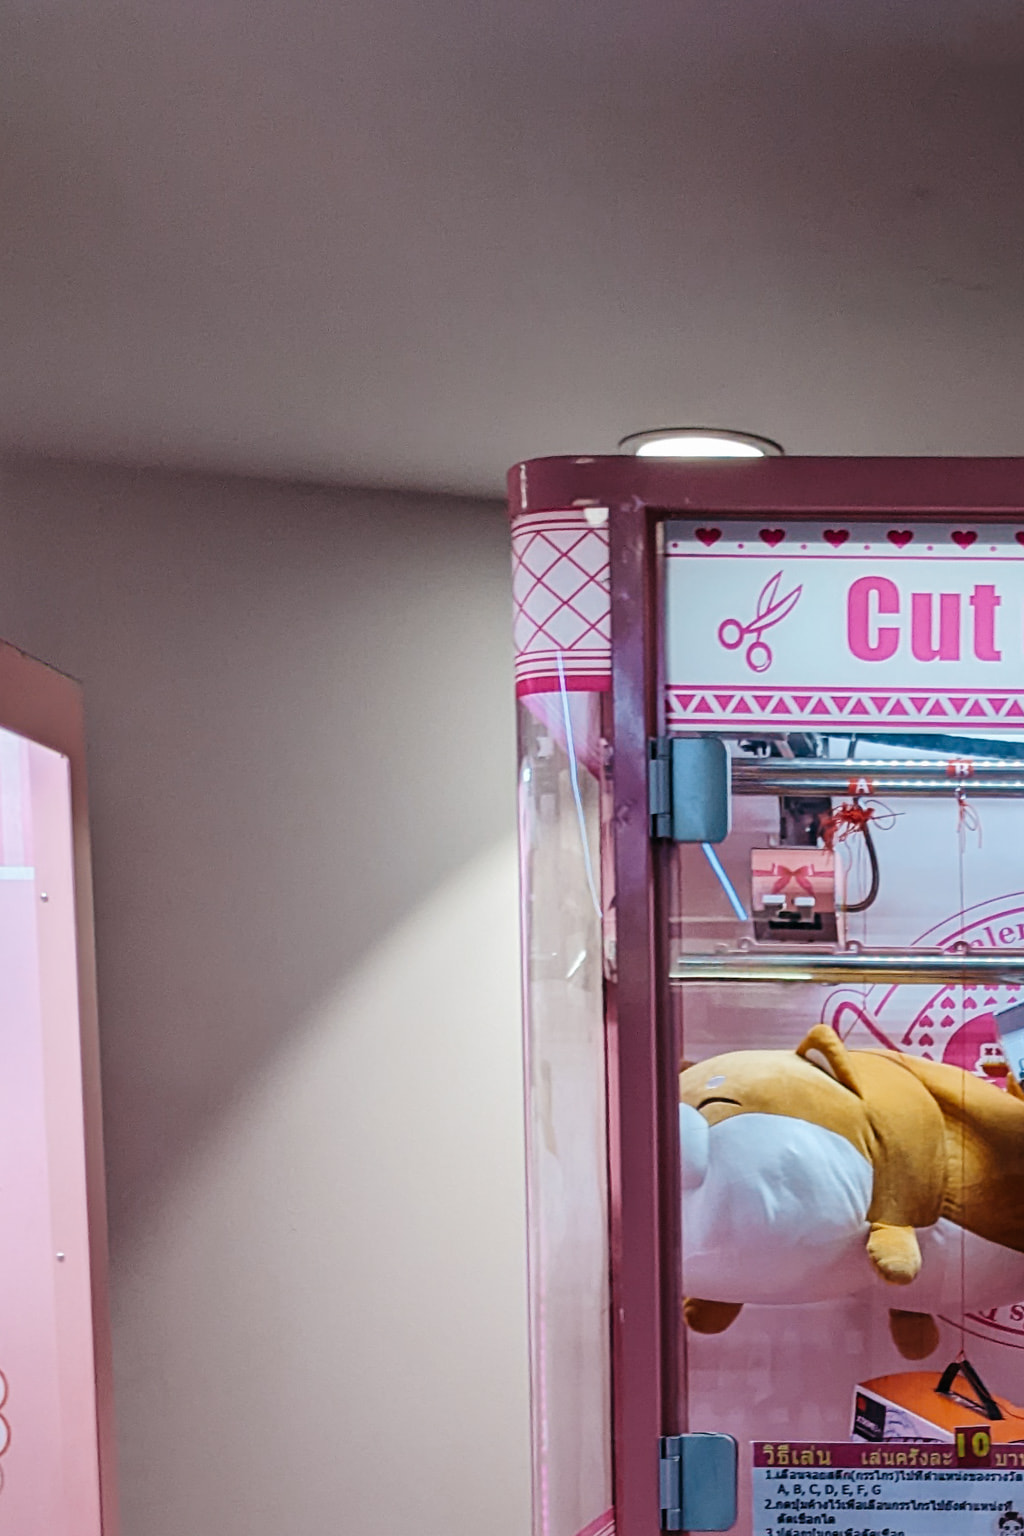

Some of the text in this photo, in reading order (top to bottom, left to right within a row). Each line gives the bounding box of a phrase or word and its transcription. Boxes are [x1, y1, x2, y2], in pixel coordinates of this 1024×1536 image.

[847, 576, 1001, 662] Cut
[954, 763, 969, 777] B
[854, 778, 870, 793] A
[763, 1443, 831, 1466] วิธีเล่น
[956, 1431, 991, 1458] 10
[777, 1484, 882, 1497] A, B, C, D, E, F, G
